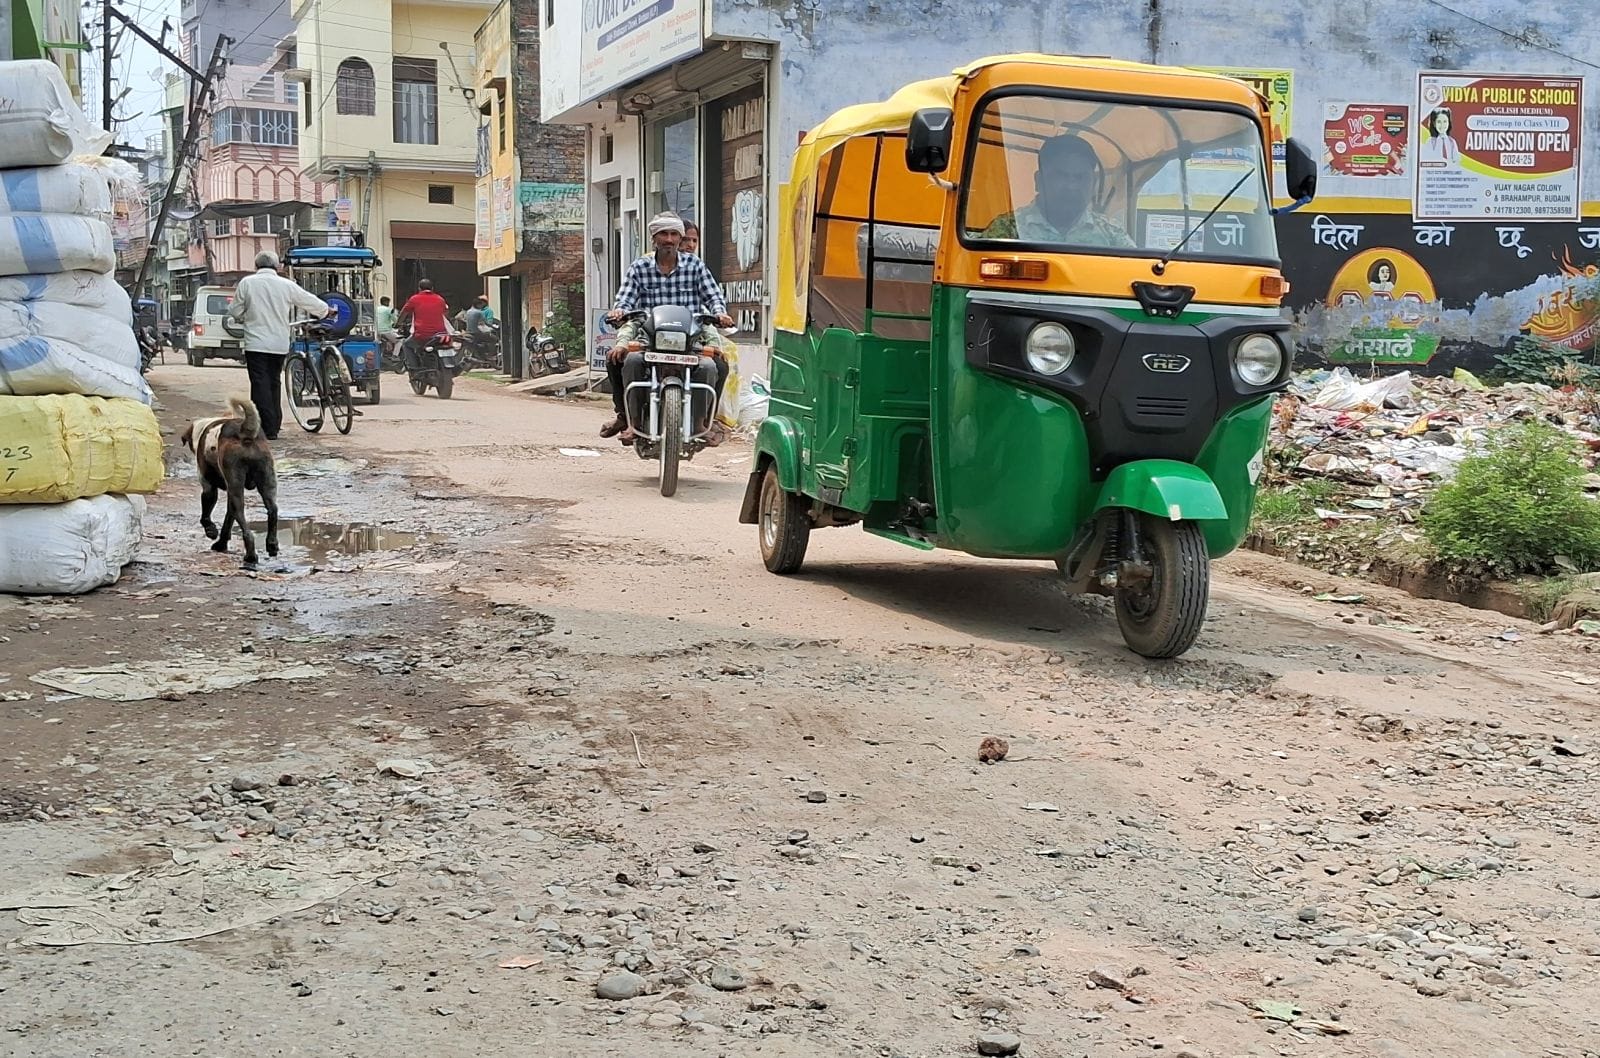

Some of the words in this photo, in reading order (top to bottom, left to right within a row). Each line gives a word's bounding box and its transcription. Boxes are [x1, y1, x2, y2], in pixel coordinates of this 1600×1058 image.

[1442, 86, 1478, 103] VIDYA
[1482, 87, 1526, 104] PUBLIC
[1529, 88, 1577, 105] SCHOOL
[1483, 106, 1518, 114] (ENGLISH
[1519, 107, 1553, 116] MEDIUM)
[1476, 120, 1490, 128] Play
[1492, 120, 1513, 128] Group
[1523, 119, 1542, 128] Class
[1545, 120, 1560, 128] VIII
[1465, 132, 1534, 151] ADMISSION
[1537, 133, 1570, 152] OPEN
[1502, 154, 1532, 165] 2024-25
[1494, 183, 1512, 191] VIJAY
[1514, 184, 1535, 192] NAGAR
[1537, 184, 1562, 192] COLONY
[1213, 215, 1246, 246] जो
[1311, 215, 1364, 250] दिल
[1495, 227, 1533, 258] छू
[1153, 358, 1180, 369] RE
